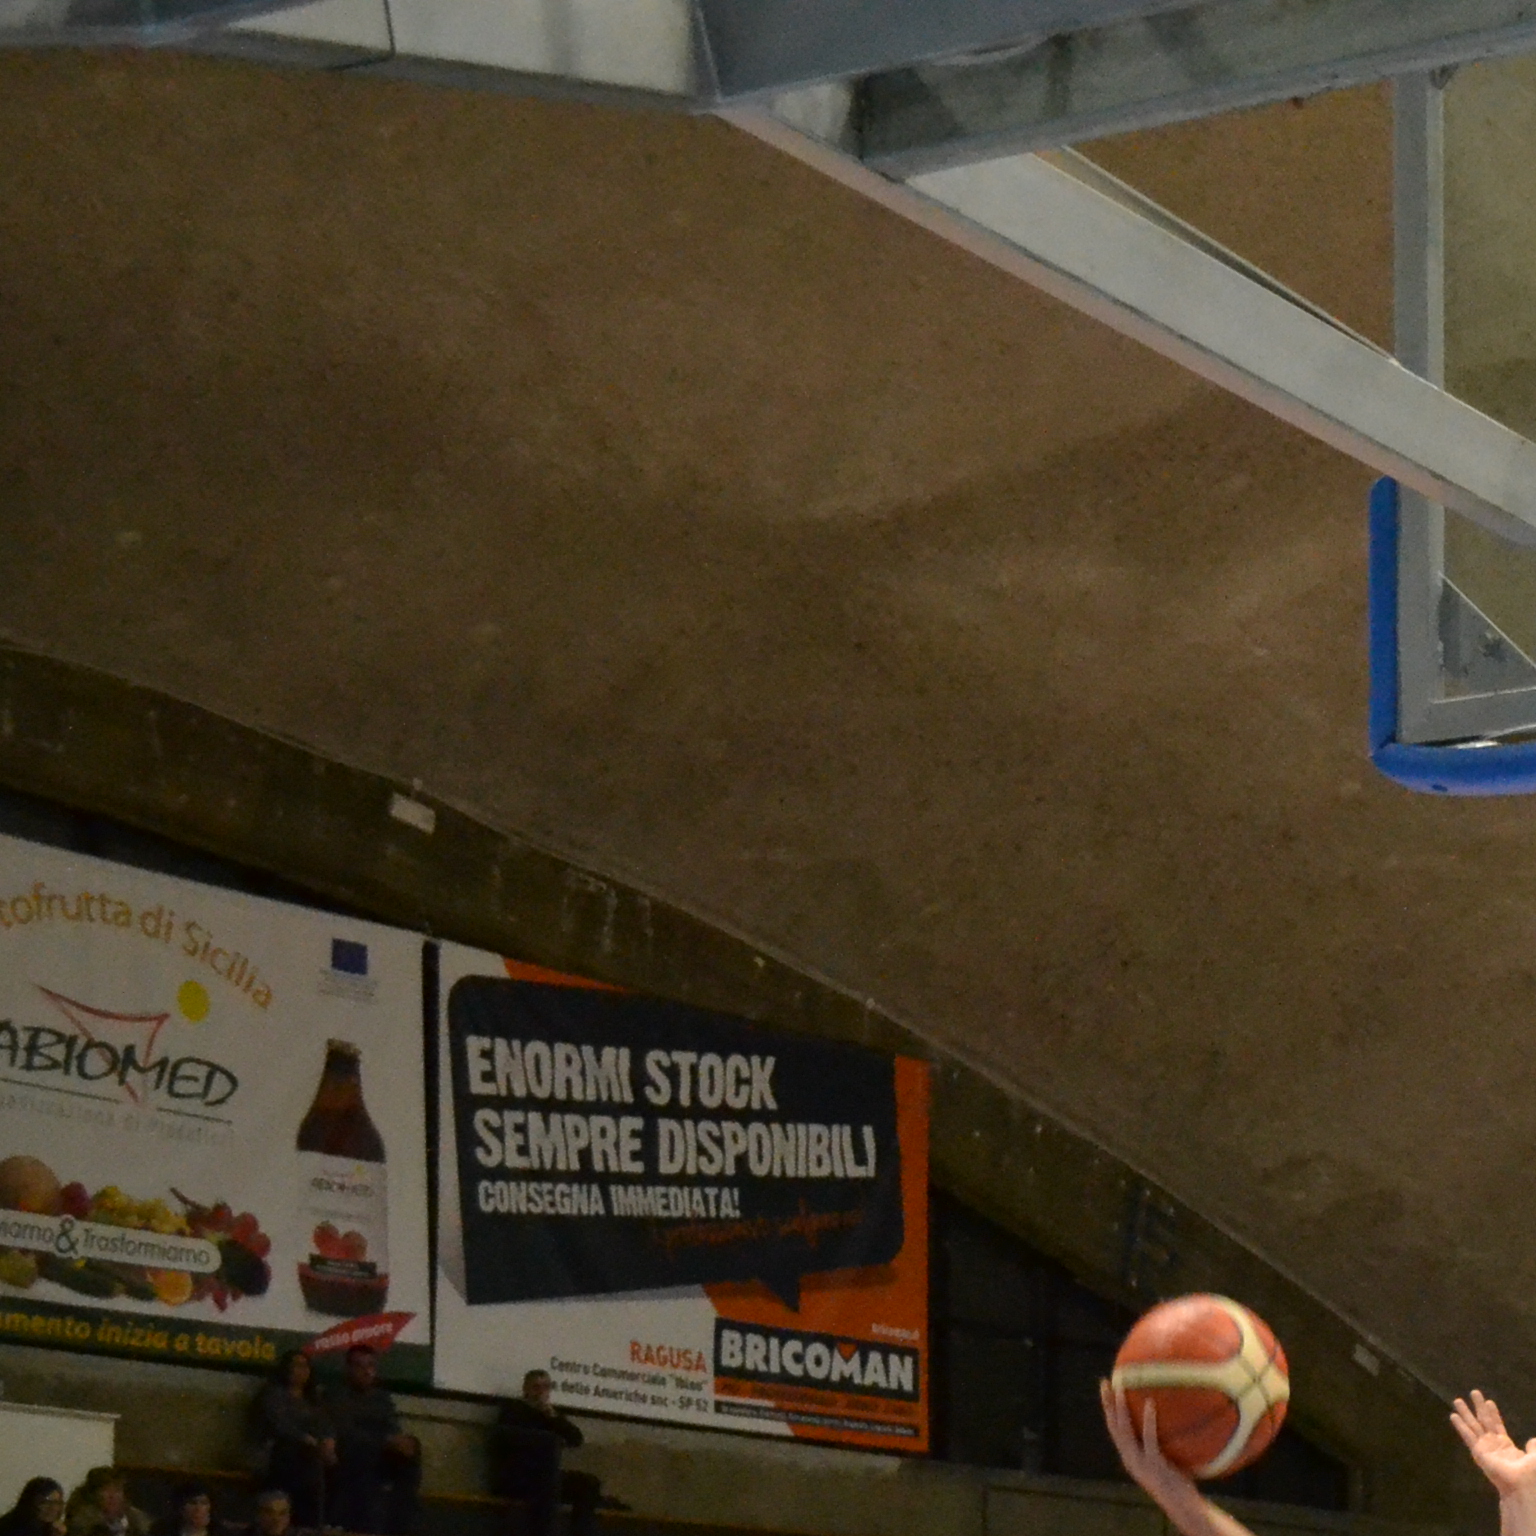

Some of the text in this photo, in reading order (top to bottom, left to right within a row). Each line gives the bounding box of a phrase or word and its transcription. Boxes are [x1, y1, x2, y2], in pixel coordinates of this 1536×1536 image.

[138, 904, 177, 945] di
[181, 918, 274, 1012] Sicilia
[465, 1034, 779, 1111] ENORMI STOCK
[473, 1108, 878, 1180] SEMPRE DISPONIBILI
[477, 1180, 742, 1220] CONSEGNA IMMEDIATA!
[82, 1230, 211, 1266] Trasformiamo
[0, 1310, 91, 1341] mento
[98, 1318, 168, 1350] inizia
[195, 1331, 277, 1362] tavola
[629, 1340, 708, 1374] RAGUSA
[720, 1328, 914, 1393] BRICOMAN
